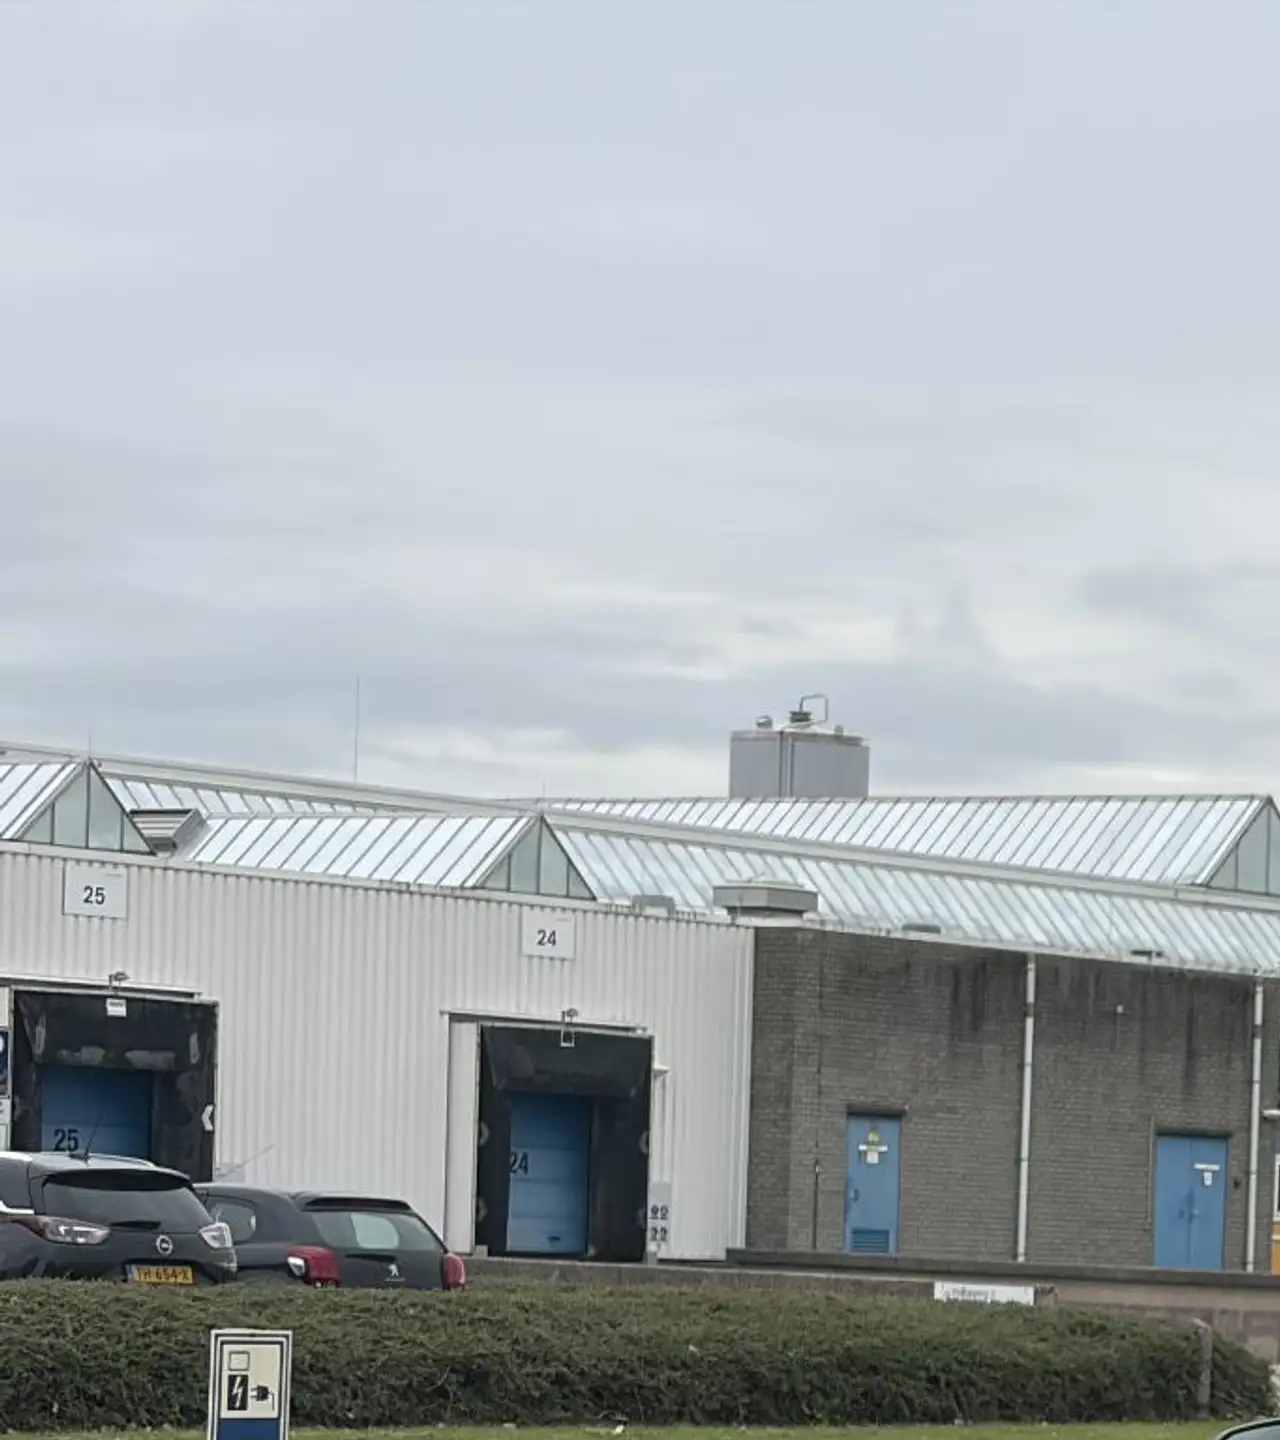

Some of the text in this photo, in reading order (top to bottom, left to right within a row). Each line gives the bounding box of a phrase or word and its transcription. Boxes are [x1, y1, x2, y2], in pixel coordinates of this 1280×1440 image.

[83, 885, 105, 905] 25
[537, 929, 556, 946] 24
[53, 1128, 79, 1152] 25
